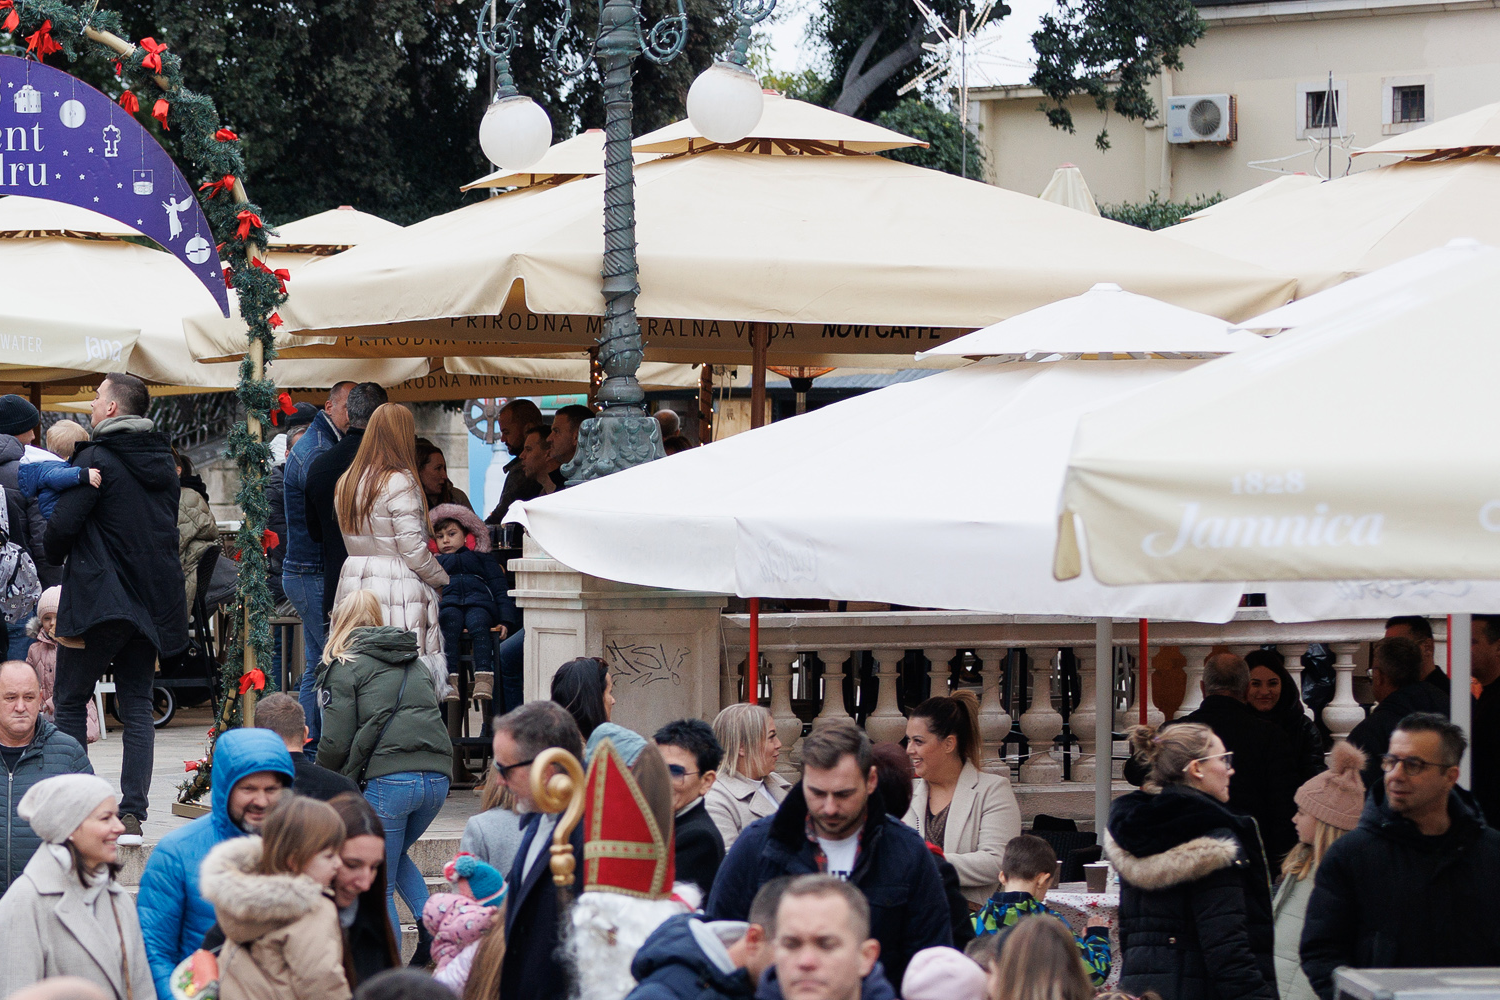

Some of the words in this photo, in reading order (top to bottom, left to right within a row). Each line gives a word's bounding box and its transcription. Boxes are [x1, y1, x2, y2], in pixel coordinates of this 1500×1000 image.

[451, 312, 573, 333] PRIRODNA
[586, 315, 721, 337] MRALNA
[734, 320, 795, 339] VDA
[0, 333, 43, 353] WATER
[1231, 470, 1305, 495] 1828
[1141, 503, 1384, 557] Jamnica
